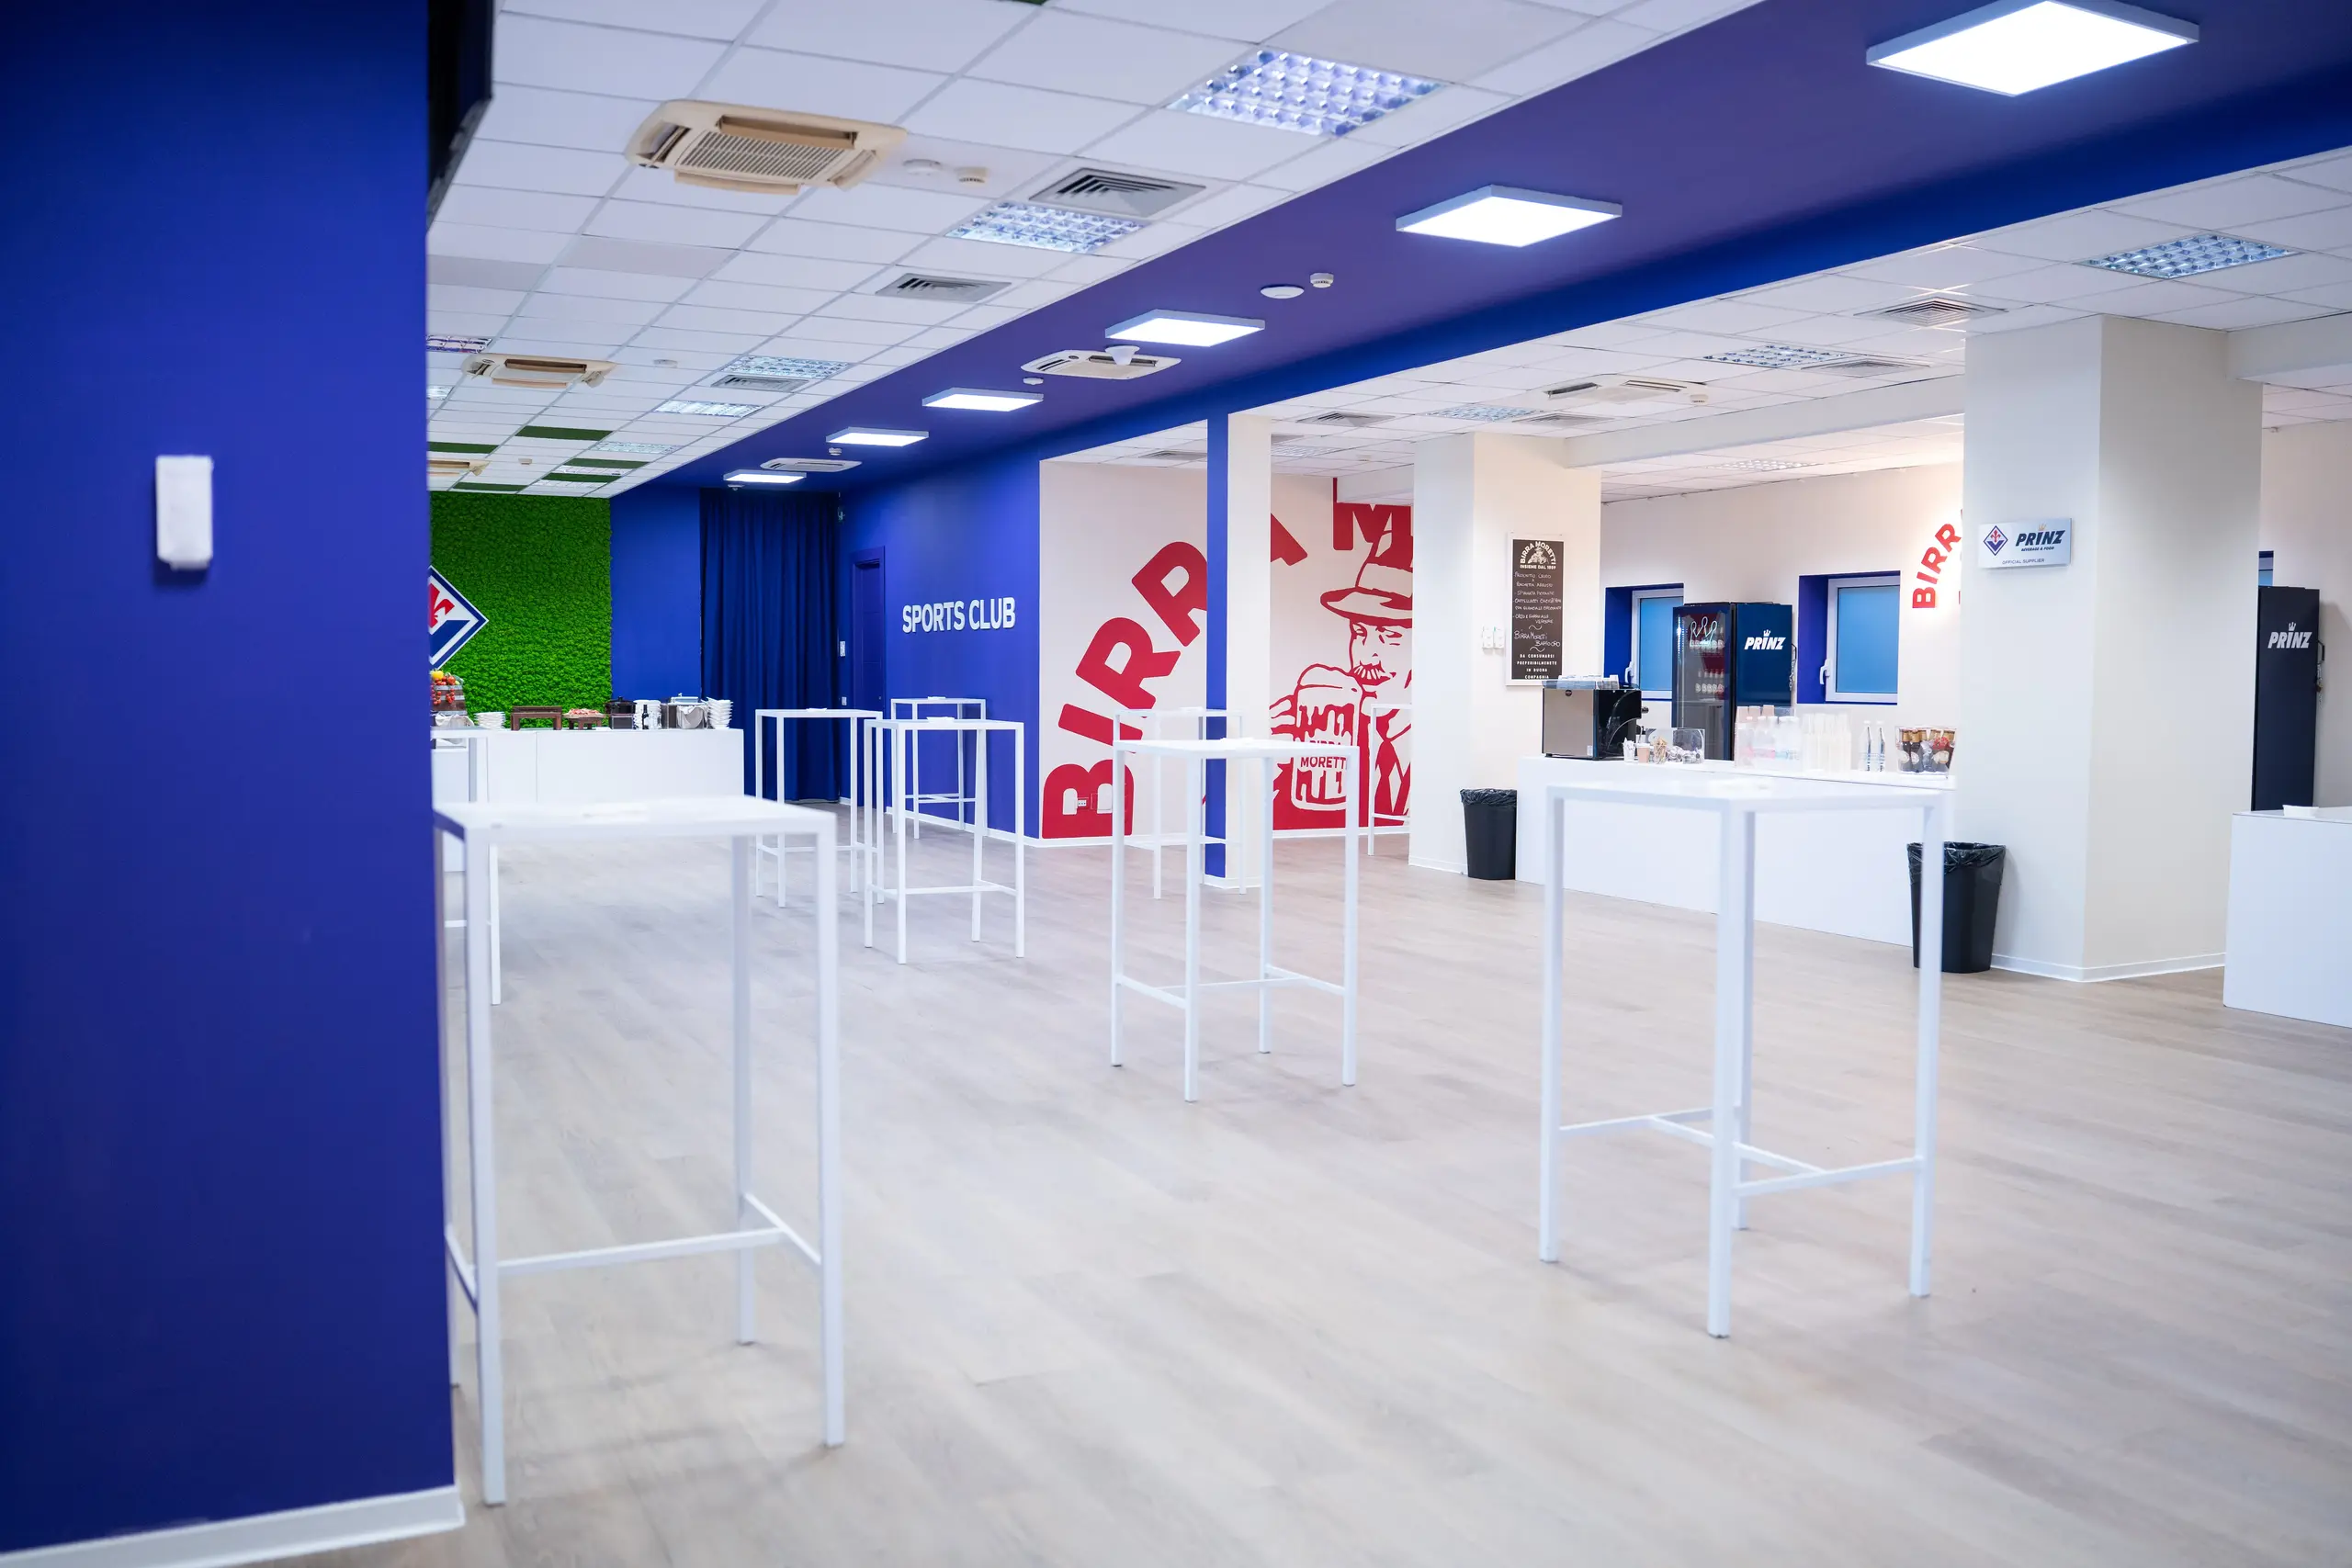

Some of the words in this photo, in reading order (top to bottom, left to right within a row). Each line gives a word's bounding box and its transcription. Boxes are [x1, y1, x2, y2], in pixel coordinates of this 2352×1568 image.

[2015, 530, 2065, 547] PRINZ
[1520, 543, 1535, 564] BIRRA
[1535, 541, 1556, 564] MORETTI
[1912, 509, 1962, 608] BIRR
[902, 600, 965, 633] SPORTS
[968, 596, 1016, 630] CLUB
[1744, 637, 1787, 650] PRINZ
[2267, 631, 2312, 649] PRINZ
[1300, 756, 1347, 769] MORETT
